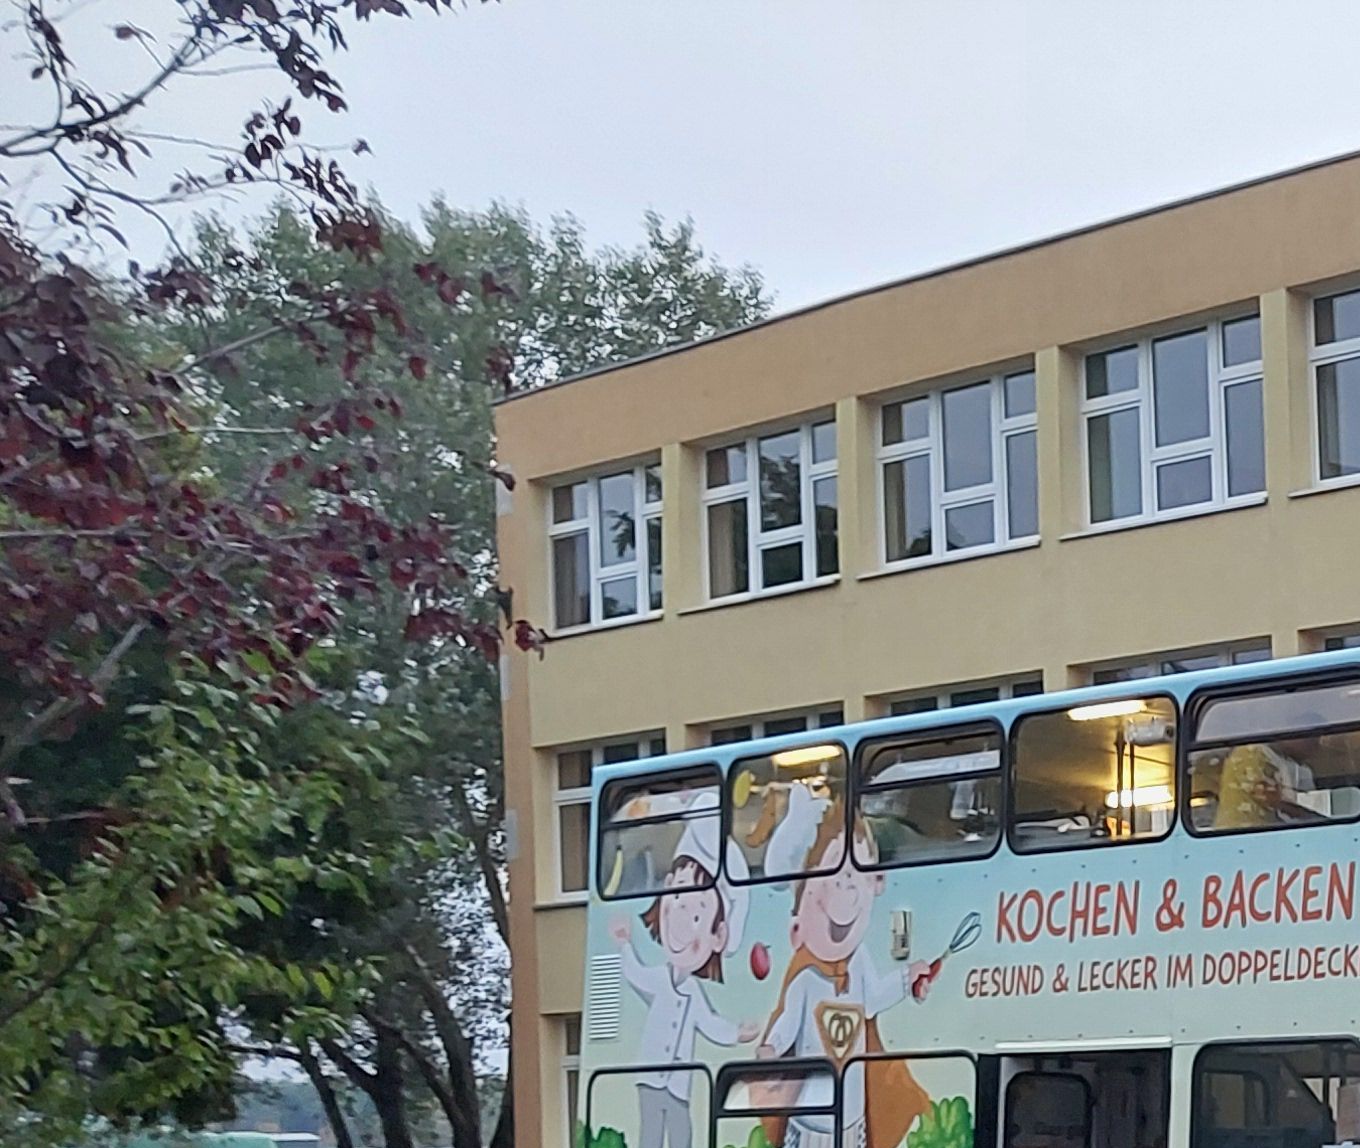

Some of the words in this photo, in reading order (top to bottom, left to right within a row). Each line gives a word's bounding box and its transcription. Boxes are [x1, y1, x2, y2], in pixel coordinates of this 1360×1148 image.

[996, 880, 1140, 944] KOCHEN
[1155, 878, 1185, 932] &
[1202, 861, 1356, 929] BACKEN
[965, 964, 1044, 998] GESUND
[1053, 963, 1069, 993] &
[1077, 955, 1158, 993] LECKER
[1166, 953, 1194, 989] IM
